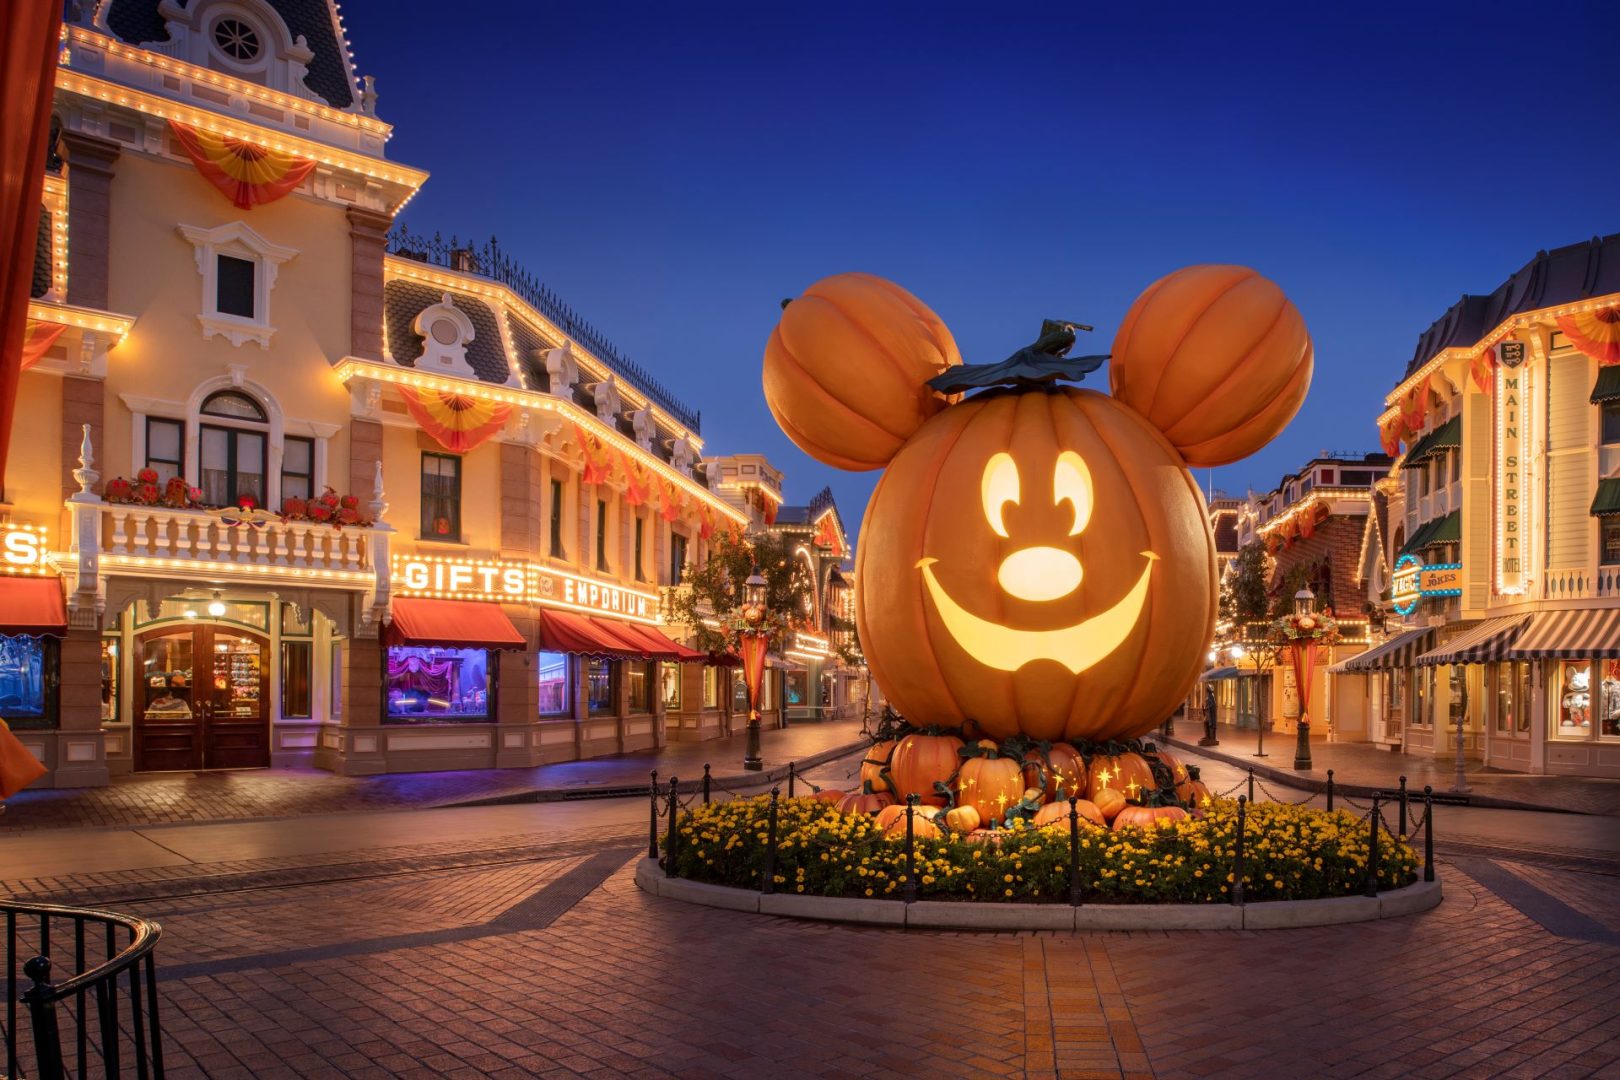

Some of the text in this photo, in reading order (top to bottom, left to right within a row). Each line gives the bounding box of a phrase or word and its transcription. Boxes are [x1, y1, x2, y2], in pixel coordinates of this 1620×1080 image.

[1504, 378, 1519, 549] MAIN STREET
[4, 531, 38, 565] S
[404, 562, 525, 595] GIFTS
[1427, 573, 1457, 587] JOKES
[565, 579, 646, 617] EMPORIUM
